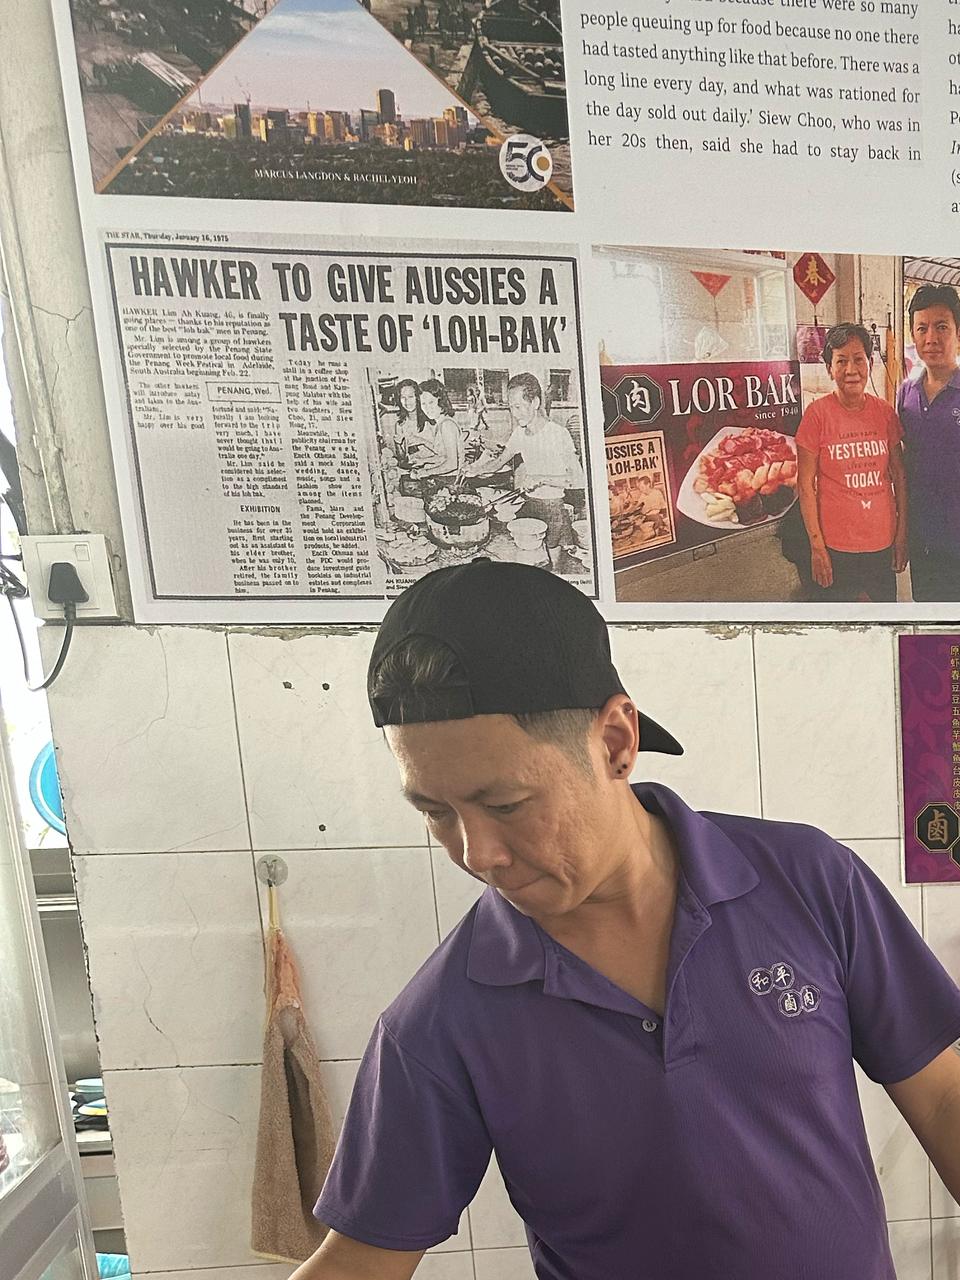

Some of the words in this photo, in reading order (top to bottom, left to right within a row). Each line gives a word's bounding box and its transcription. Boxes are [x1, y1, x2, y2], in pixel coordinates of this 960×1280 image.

[581, 11, 628, 31] people
[632, 15, 691, 36] queuing
[695, 20, 713, 37] up
[718, 17, 737, 34] for
[741, 18, 772, 36] food
[775, 20, 831, 40] because
[834, 29, 851, 41] no
[856, 30, 880, 43] one
[884, 28, 919, 44] there
[582, 40, 609, 56] had
[612, 43, 658, 59] tasted
[662, 46, 726, 68] anything
[729, 48, 754, 64] like
[757, 50, 788, 66] that
[790, 51, 837, 70] before.
[840, 55, 879, 72] There
[883, 61, 909, 74] was
[913, 63, 919, 74] a
[584, 70, 615, 91] long
[620, 72, 648, 88] line
[654, 78, 692, 95] every
[699, 76, 726, 97] day,
[733, 79, 759, 94] and
[764, 80, 801, 97] what
[806, 87, 833, 99] was
[839, 86, 896, 103] rationed
[902, 88, 920, 103] for
[130, 255, 260, 302] HAWKER
[272, 262, 311, 302] TO
[328, 265, 393, 304] GIVE
[406, 268, 527, 305] AUSSIES
[539, 269, 558, 305] A
[278, 312, 372, 353] TASTE
[378, 314, 413, 353] OF
[423, 315, 567, 354] 'LOH-BAK'
[217, 387, 253, 395] PENANG,
[669, 378, 738, 416] LOR
[744, 373, 798, 408] BAK
[755, 409, 776, 420] since
[605, 444, 643, 460] USSIES
[828, 441, 890, 460] YESTERDAY
[844, 472, 883, 489] TODAY.
[240, 505, 280, 513] EXHIBITION
